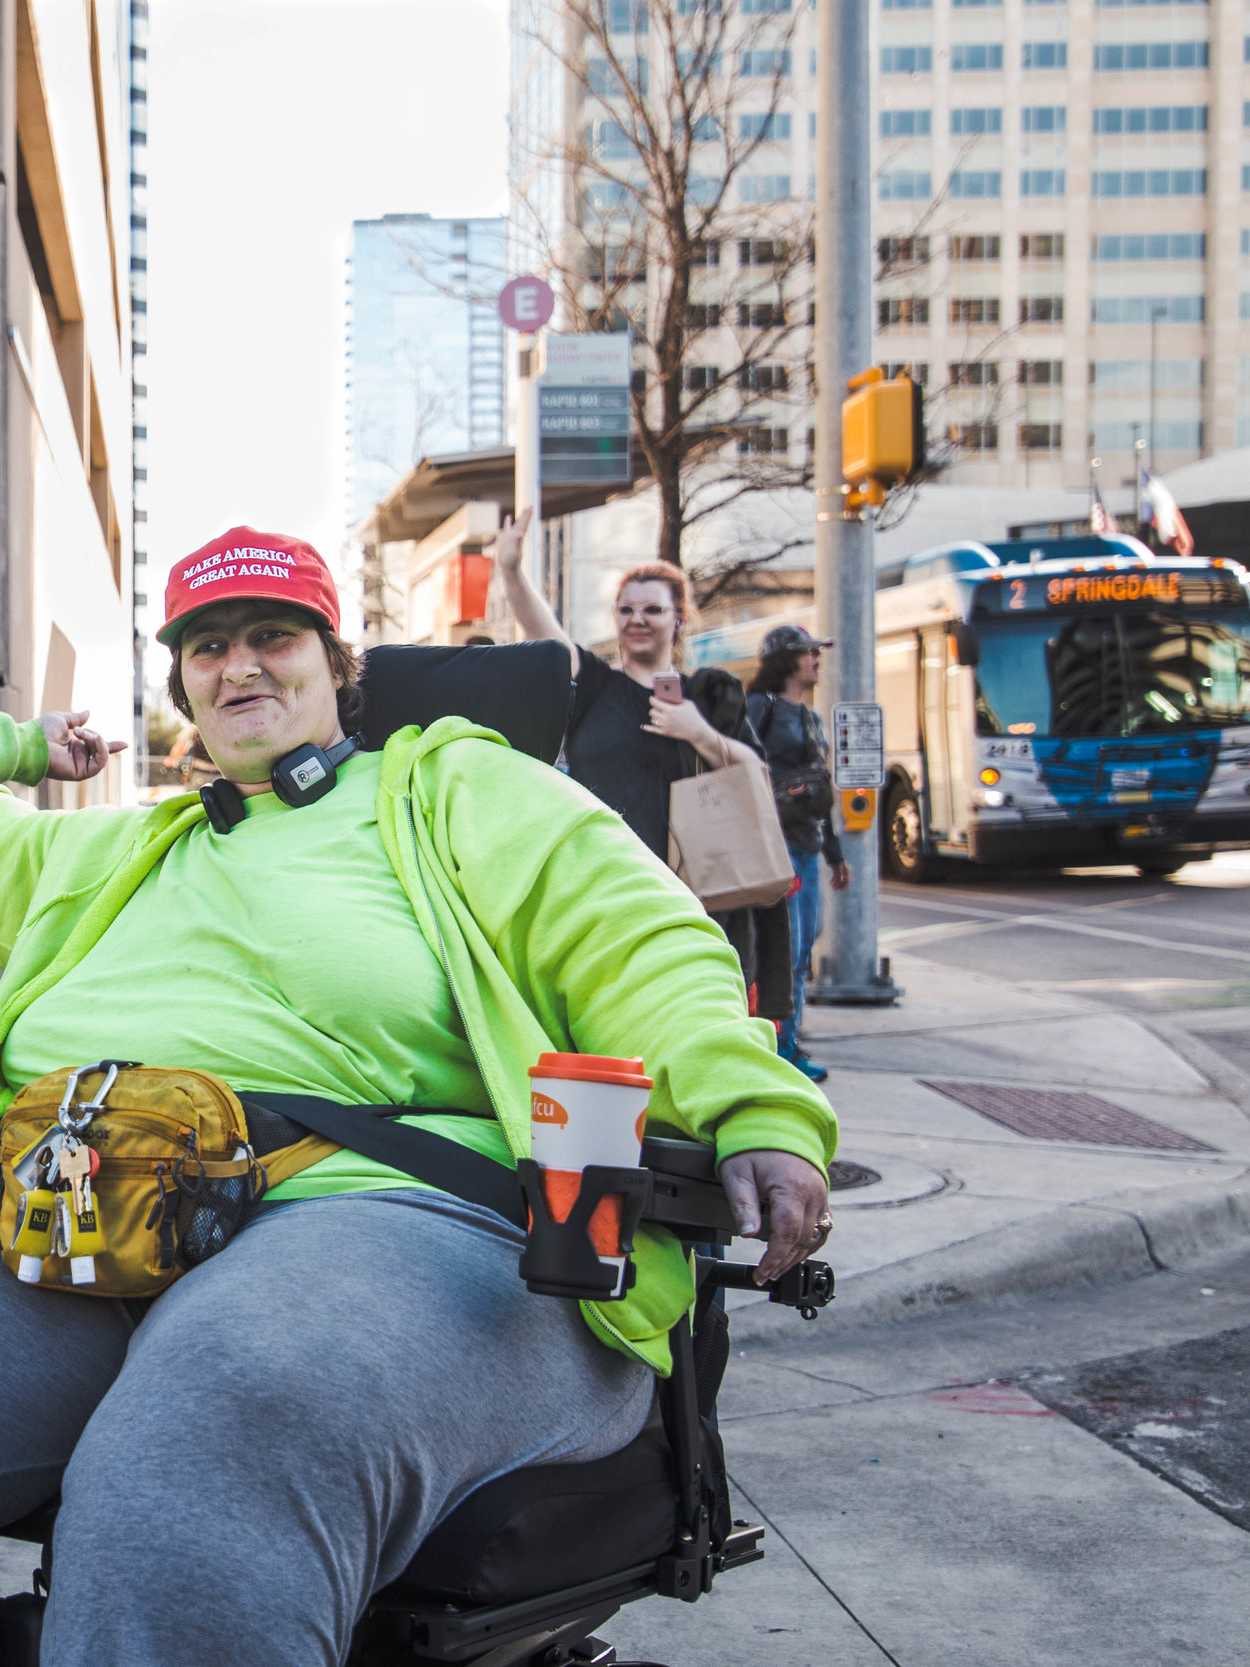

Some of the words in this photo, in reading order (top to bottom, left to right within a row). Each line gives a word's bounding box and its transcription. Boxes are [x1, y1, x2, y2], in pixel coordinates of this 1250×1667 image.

[514, 285, 539, 320] E
[541, 393, 578, 408] RAPID
[541, 416, 578, 430] RAPID
[181, 553, 222, 581] MAKE
[222, 547, 297, 566] AMERICA
[189, 565, 237, 590] GREAT
[238, 563, 290, 579] AGAIN
[1009, 579, 1027, 610] 2
[1047, 572, 1182, 605] SPRINGDALE
[33, 1211, 48, 1223] KB
[80, 1214, 94, 1225] KB
